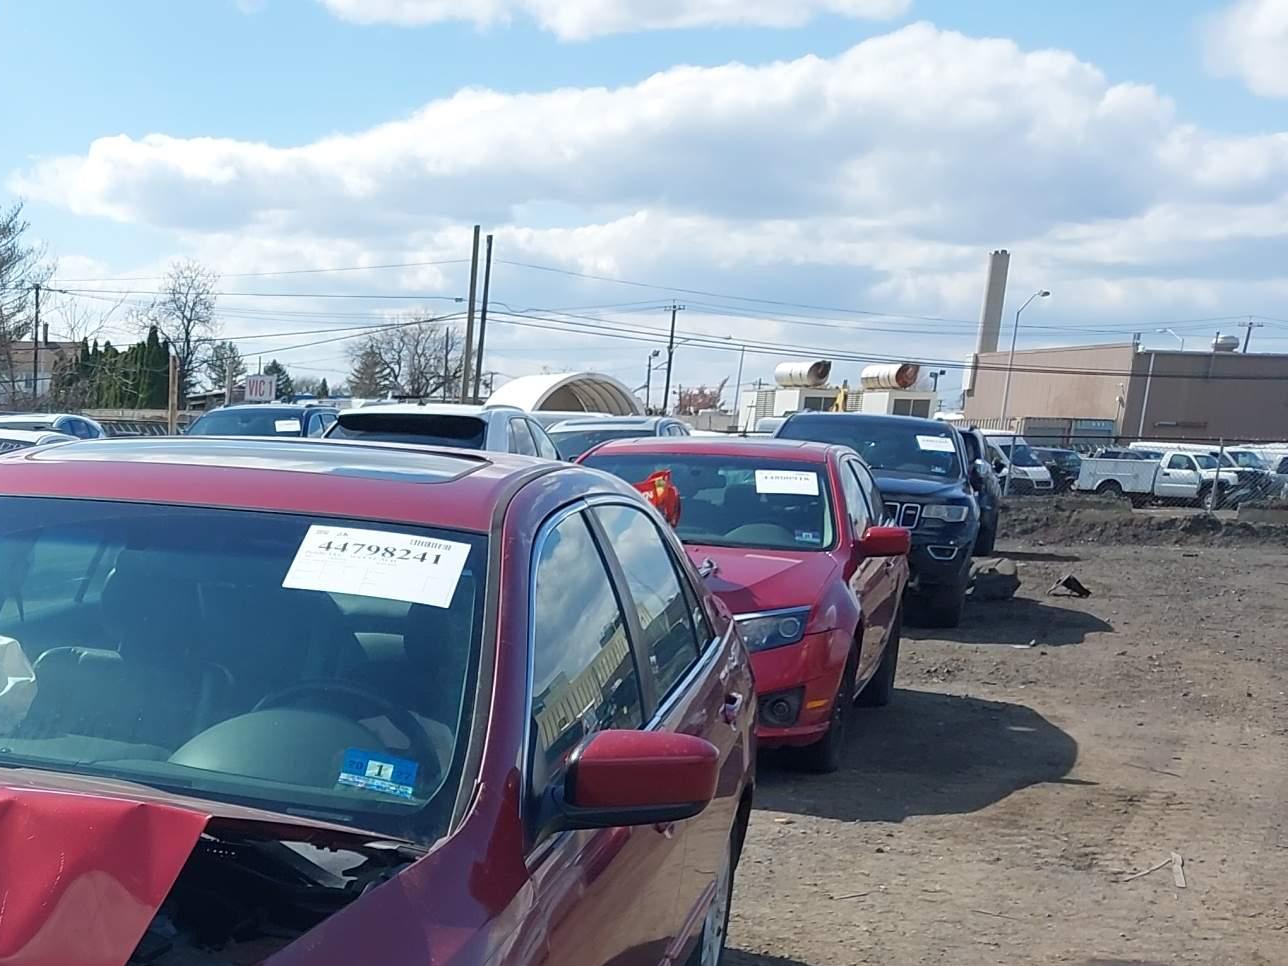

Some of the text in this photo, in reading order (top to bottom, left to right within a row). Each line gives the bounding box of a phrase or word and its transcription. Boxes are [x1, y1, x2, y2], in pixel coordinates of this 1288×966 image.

[249, 379, 265, 397] VIC
[317, 540, 442, 565] 44798241
[375, 765, 383, 776] 1
